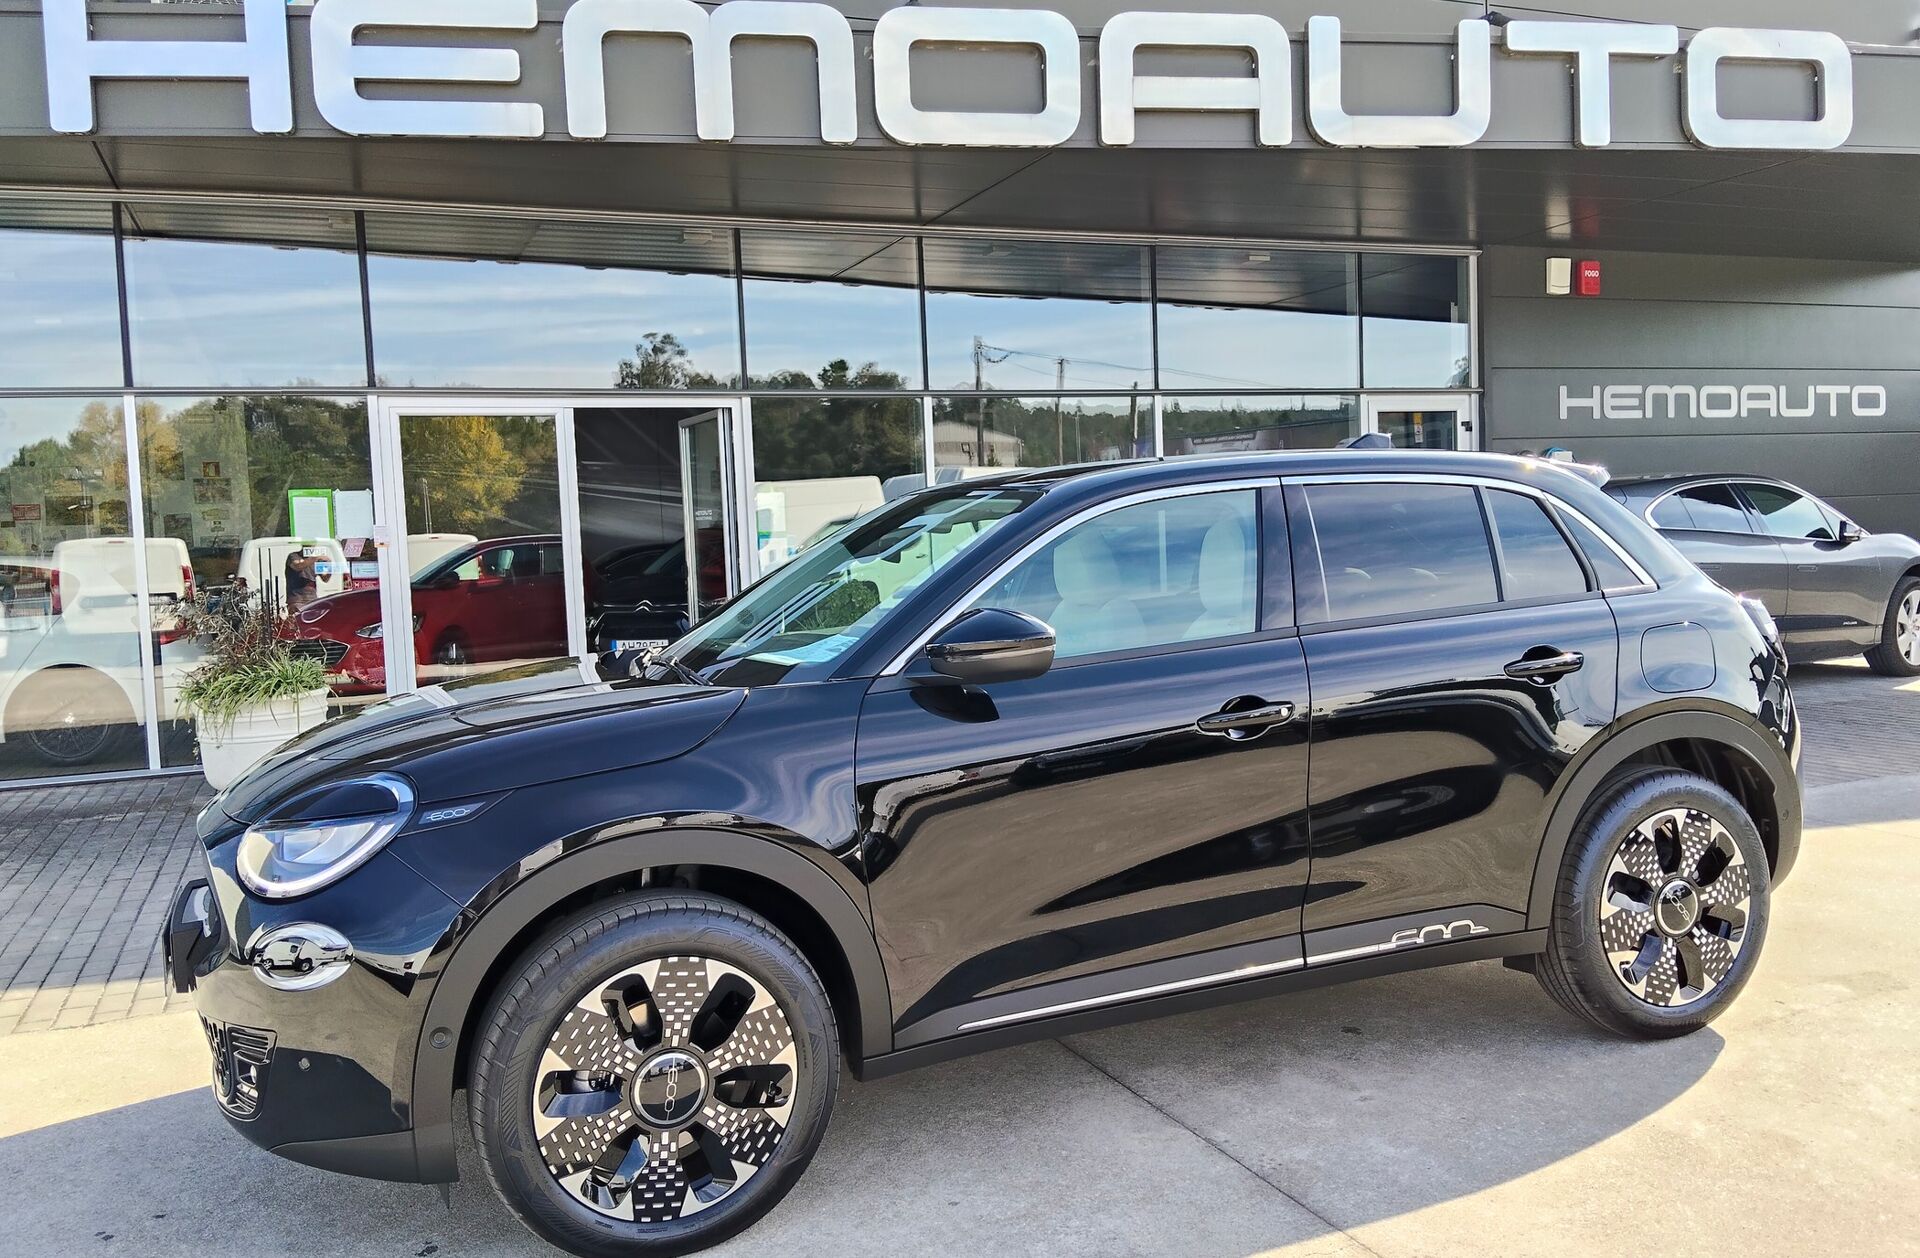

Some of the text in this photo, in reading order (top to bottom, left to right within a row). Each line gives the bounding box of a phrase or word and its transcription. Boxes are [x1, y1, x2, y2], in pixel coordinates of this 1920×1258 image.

[44, 0, 1853, 149] HEMOAUTO
[1584, 270, 1600, 278] FOGO
[1559, 384, 1886, 419] HEMOAUTO
[429, 808, 468, 821] 600
[1669, 895, 1691, 921] 600
[664, 1067, 678, 1113] 600
